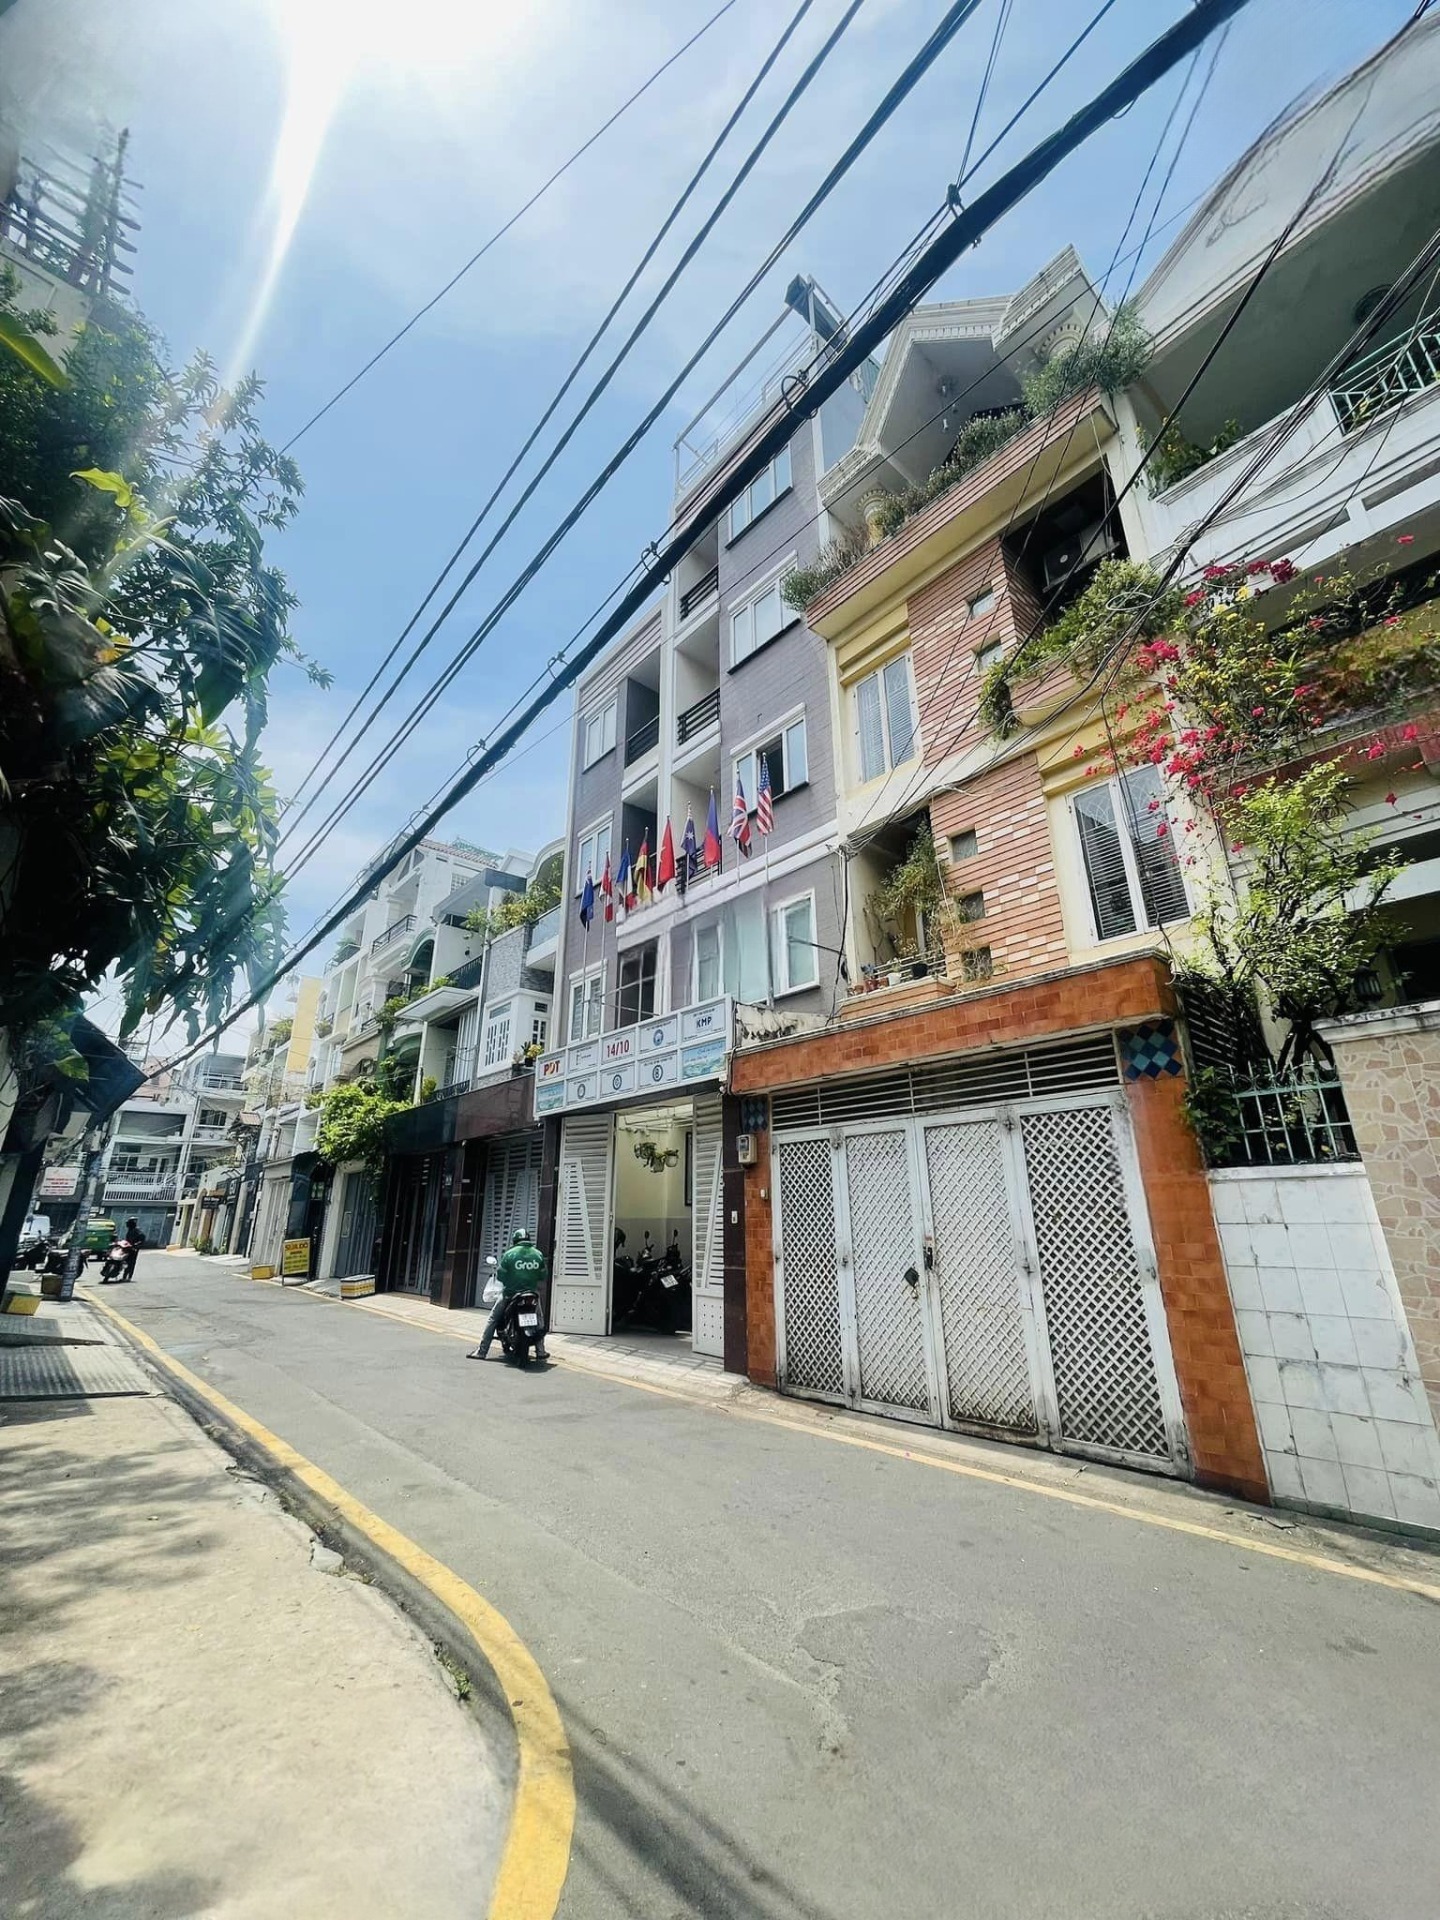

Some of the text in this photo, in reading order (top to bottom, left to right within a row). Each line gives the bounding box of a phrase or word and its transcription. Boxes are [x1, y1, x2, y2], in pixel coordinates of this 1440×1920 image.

[696, 1017, 712, 1028] KMP
[606, 1039, 630, 1058] 14/10
[544, 1060, 560, 1076] PDT
[514, 1260, 540, 1270] Grab
